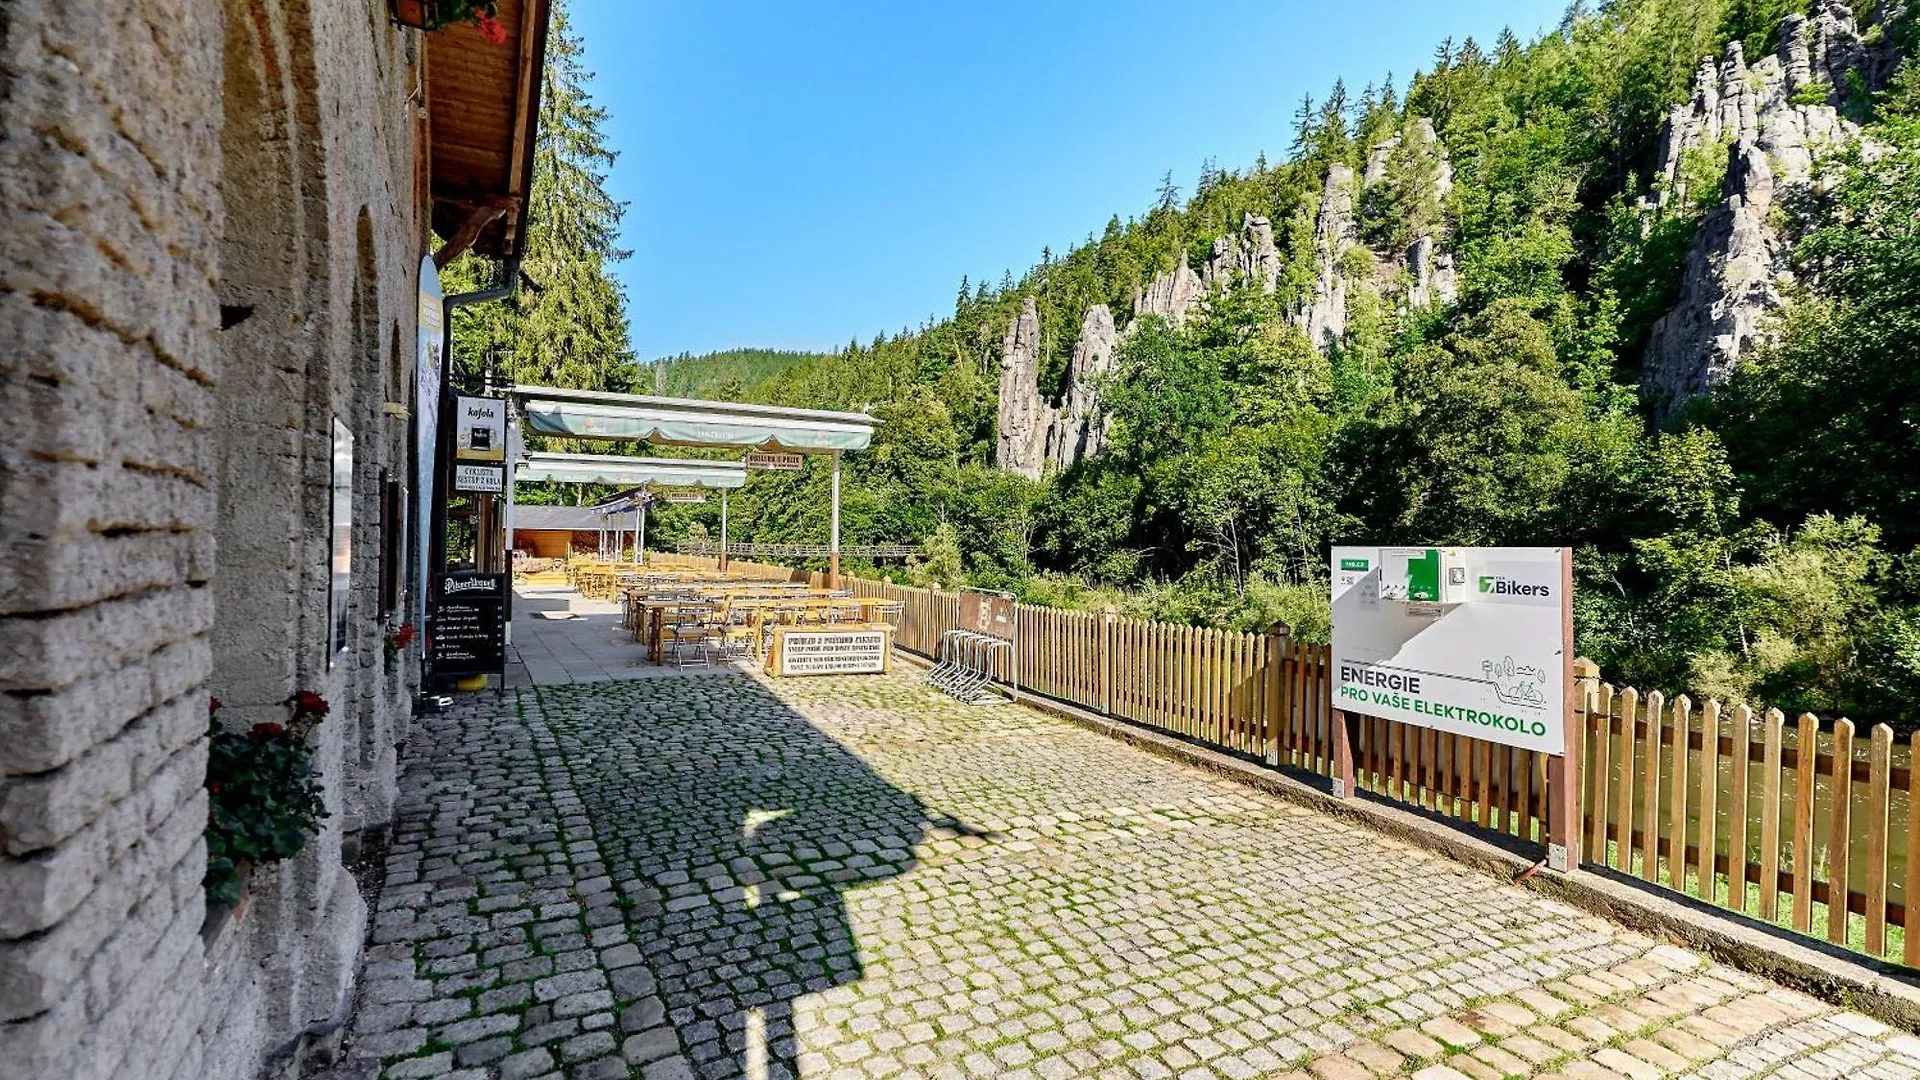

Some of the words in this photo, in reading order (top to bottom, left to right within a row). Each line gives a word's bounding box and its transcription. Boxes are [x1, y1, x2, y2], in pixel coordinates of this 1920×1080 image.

[468, 407, 494, 419] kofola
[1496, 580, 1550, 597] Bikers
[1341, 666, 1420, 695] ENERGIE
[1340, 686, 1368, 702] PRO
[1373, 692, 1410, 711] VAŠE
[1415, 700, 1546, 737] ELEKTROKOLO
